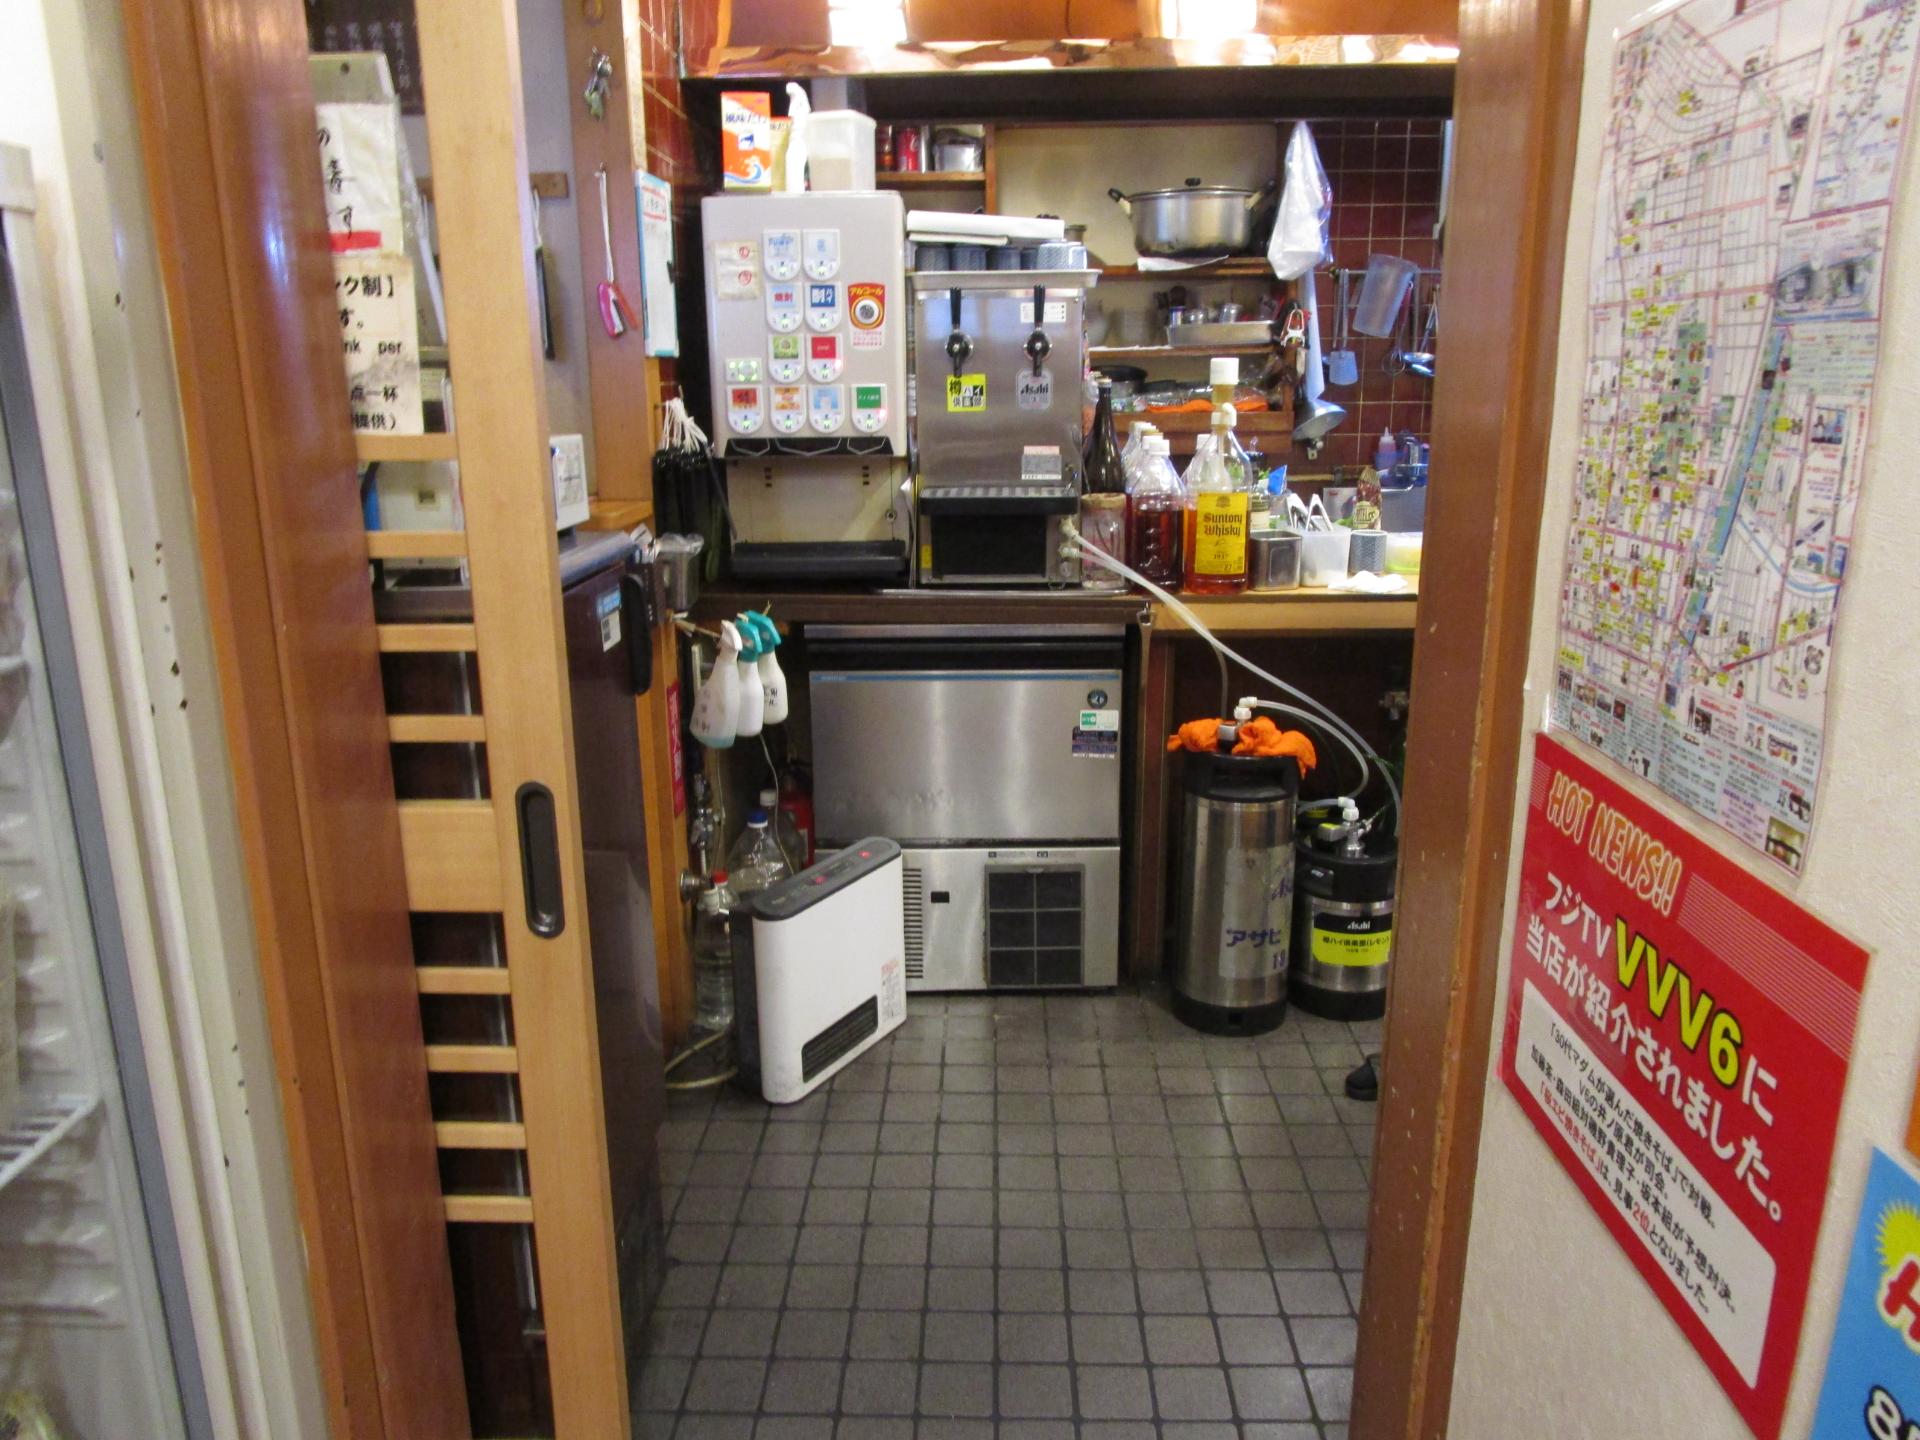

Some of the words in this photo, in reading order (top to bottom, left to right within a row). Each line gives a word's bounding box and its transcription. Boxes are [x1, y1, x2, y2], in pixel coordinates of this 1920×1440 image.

[335, 274, 395, 298] ク制】
[1020, 383, 1049, 396] Asahi
[1203, 512, 1242, 525] Suntory
[1203, 525, 1240, 537] Whisky
[1547, 770, 1594, 845] HOT
[1588, 802, 1682, 918] NEWS!!
[1347, 920, 1371, 930] Asahi
[1226, 928, 1282, 948] アサヒ
[1545, 871, 1612, 959] フジTV
[1615, 912, 1745, 1090] VVV6
[1525, 912, 1782, 1222] 当店が紹介されました。
